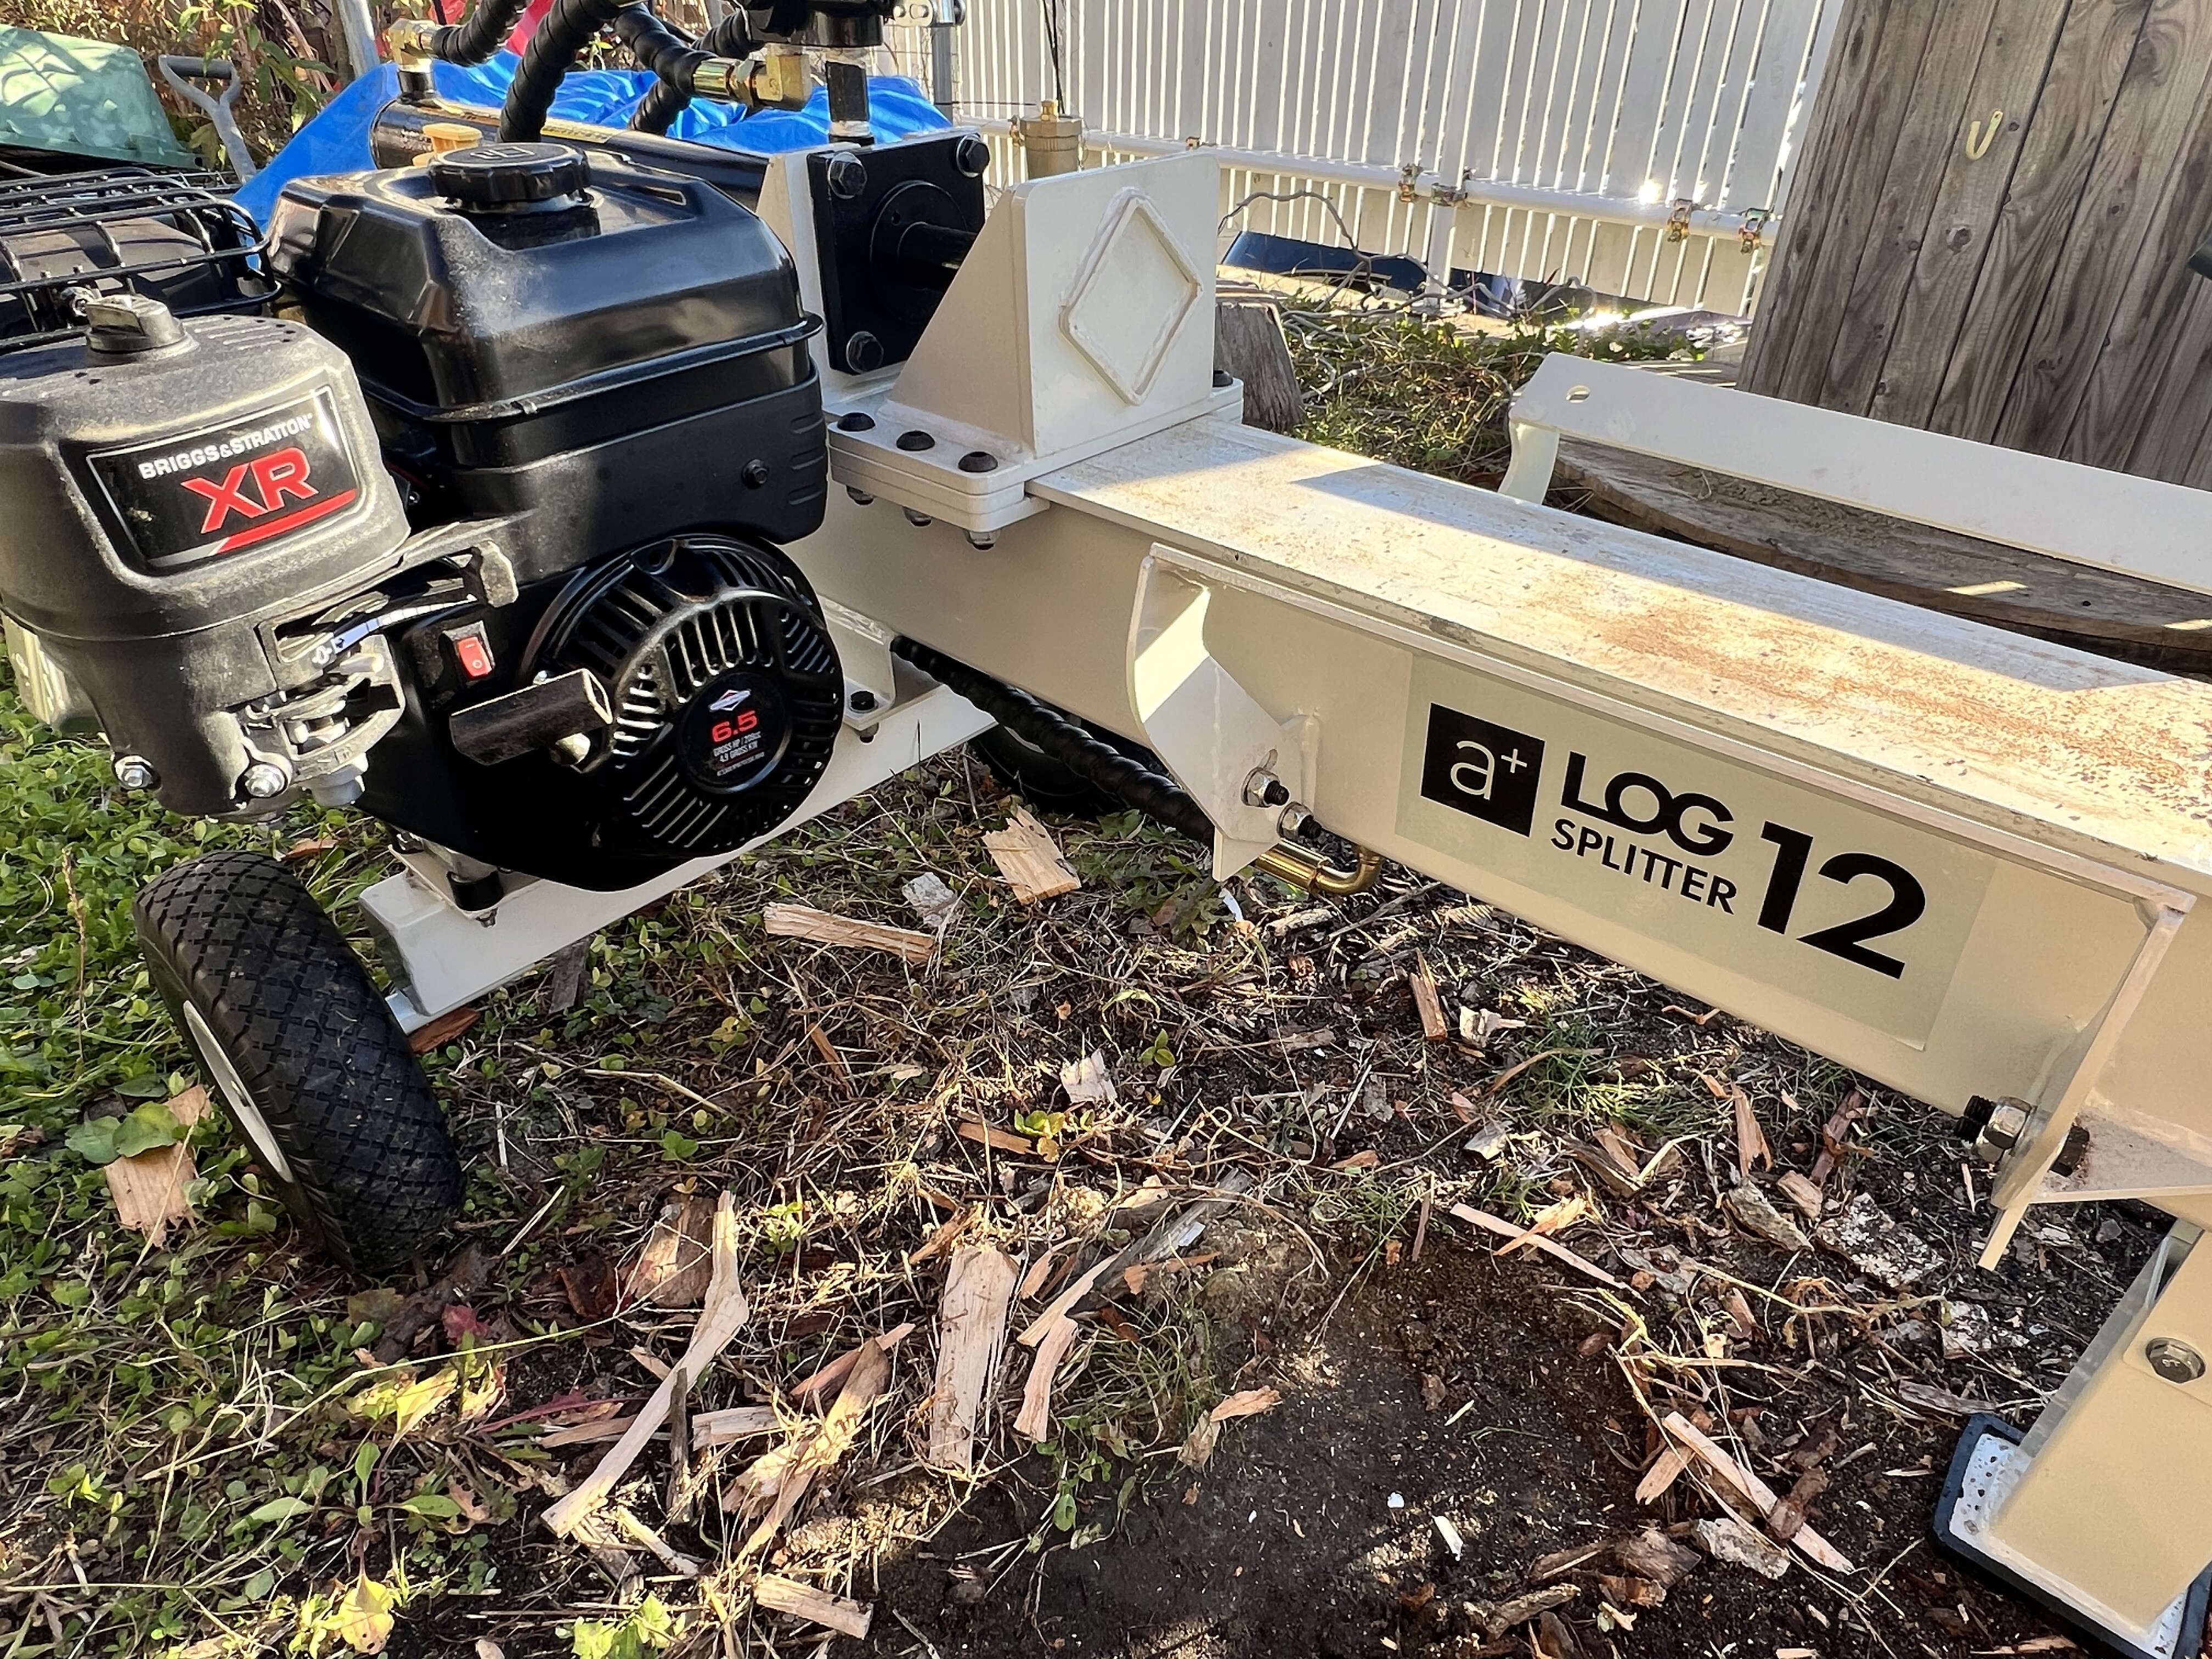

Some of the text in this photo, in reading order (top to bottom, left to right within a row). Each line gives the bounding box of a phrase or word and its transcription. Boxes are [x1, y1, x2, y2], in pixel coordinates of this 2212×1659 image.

[180, 447, 319, 534] XR
[712, 710, 757, 742] 6.5
[1450, 740, 1528, 801] a+
[1560, 751, 1734, 856] LOG
[1550, 819, 1737, 915] SPLITTER
[1757, 821, 1926, 980] 12
